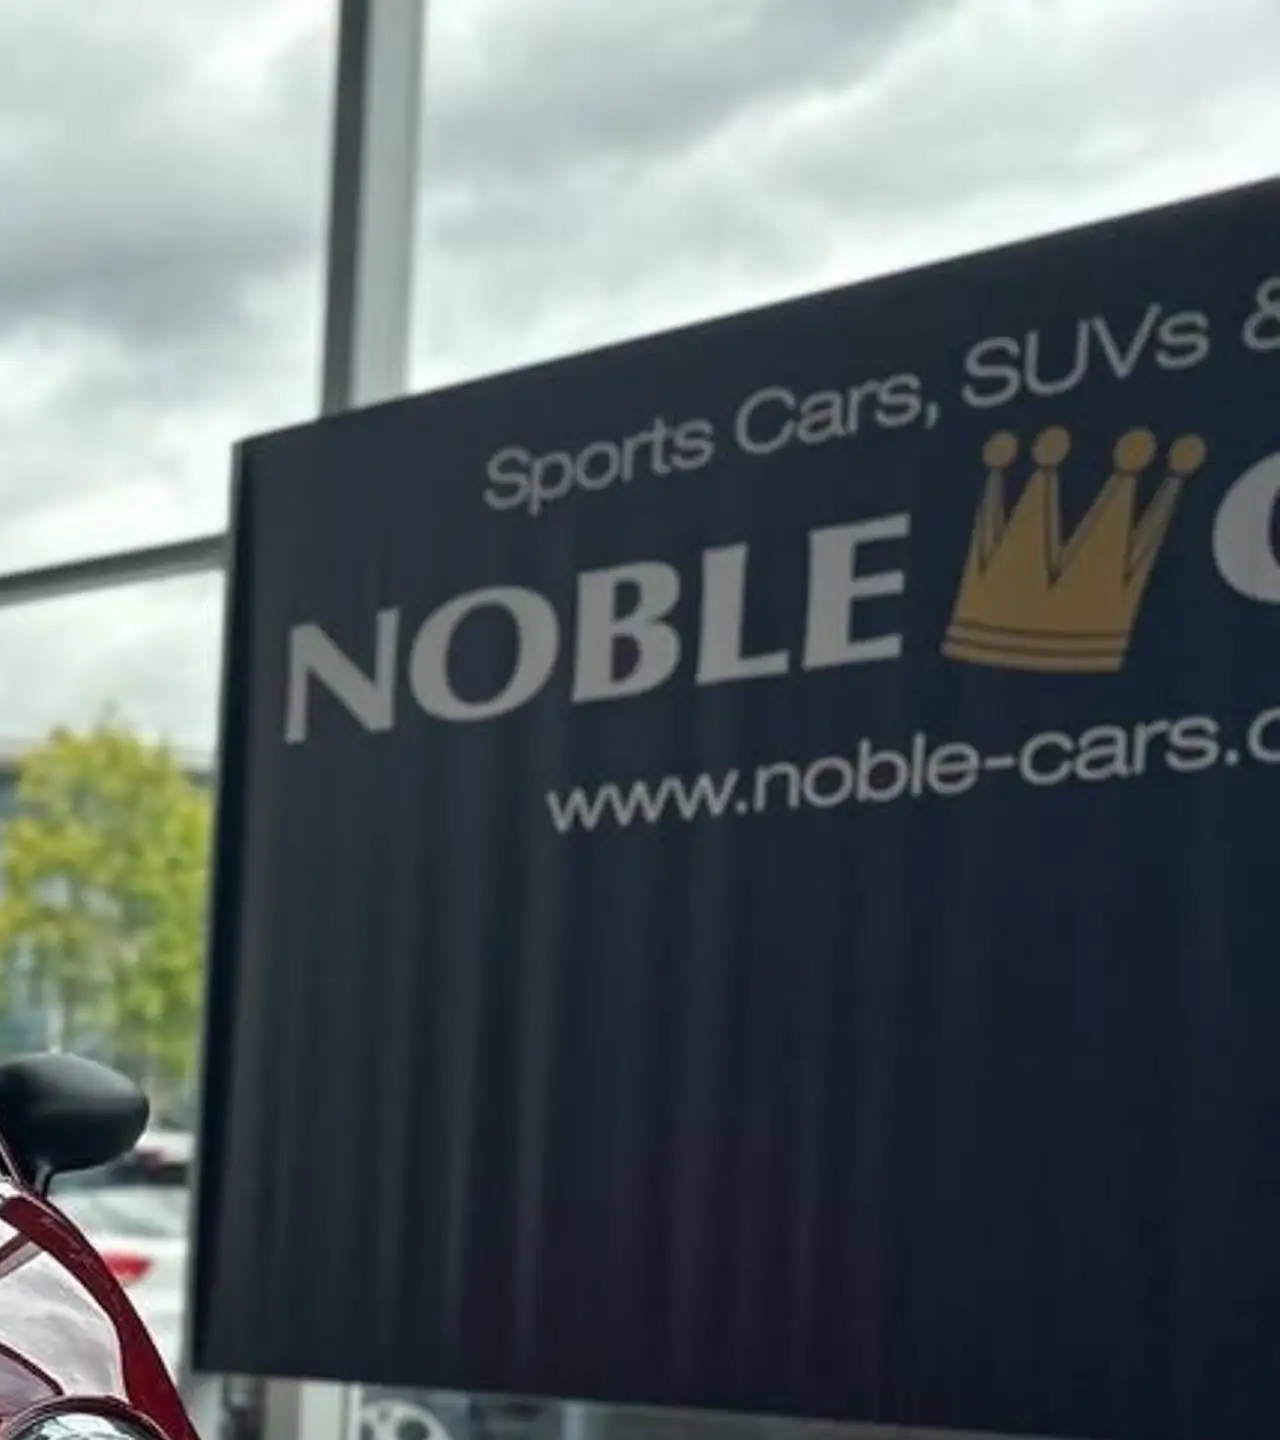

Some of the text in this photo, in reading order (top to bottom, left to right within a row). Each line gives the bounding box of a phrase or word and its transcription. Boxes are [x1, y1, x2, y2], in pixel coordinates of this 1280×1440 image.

[485, 416, 713, 516] Sports
[735, 371, 942, 455] Cars,
[961, 302, 1211, 408] SUVs
[283, 513, 911, 746] NOBLE
